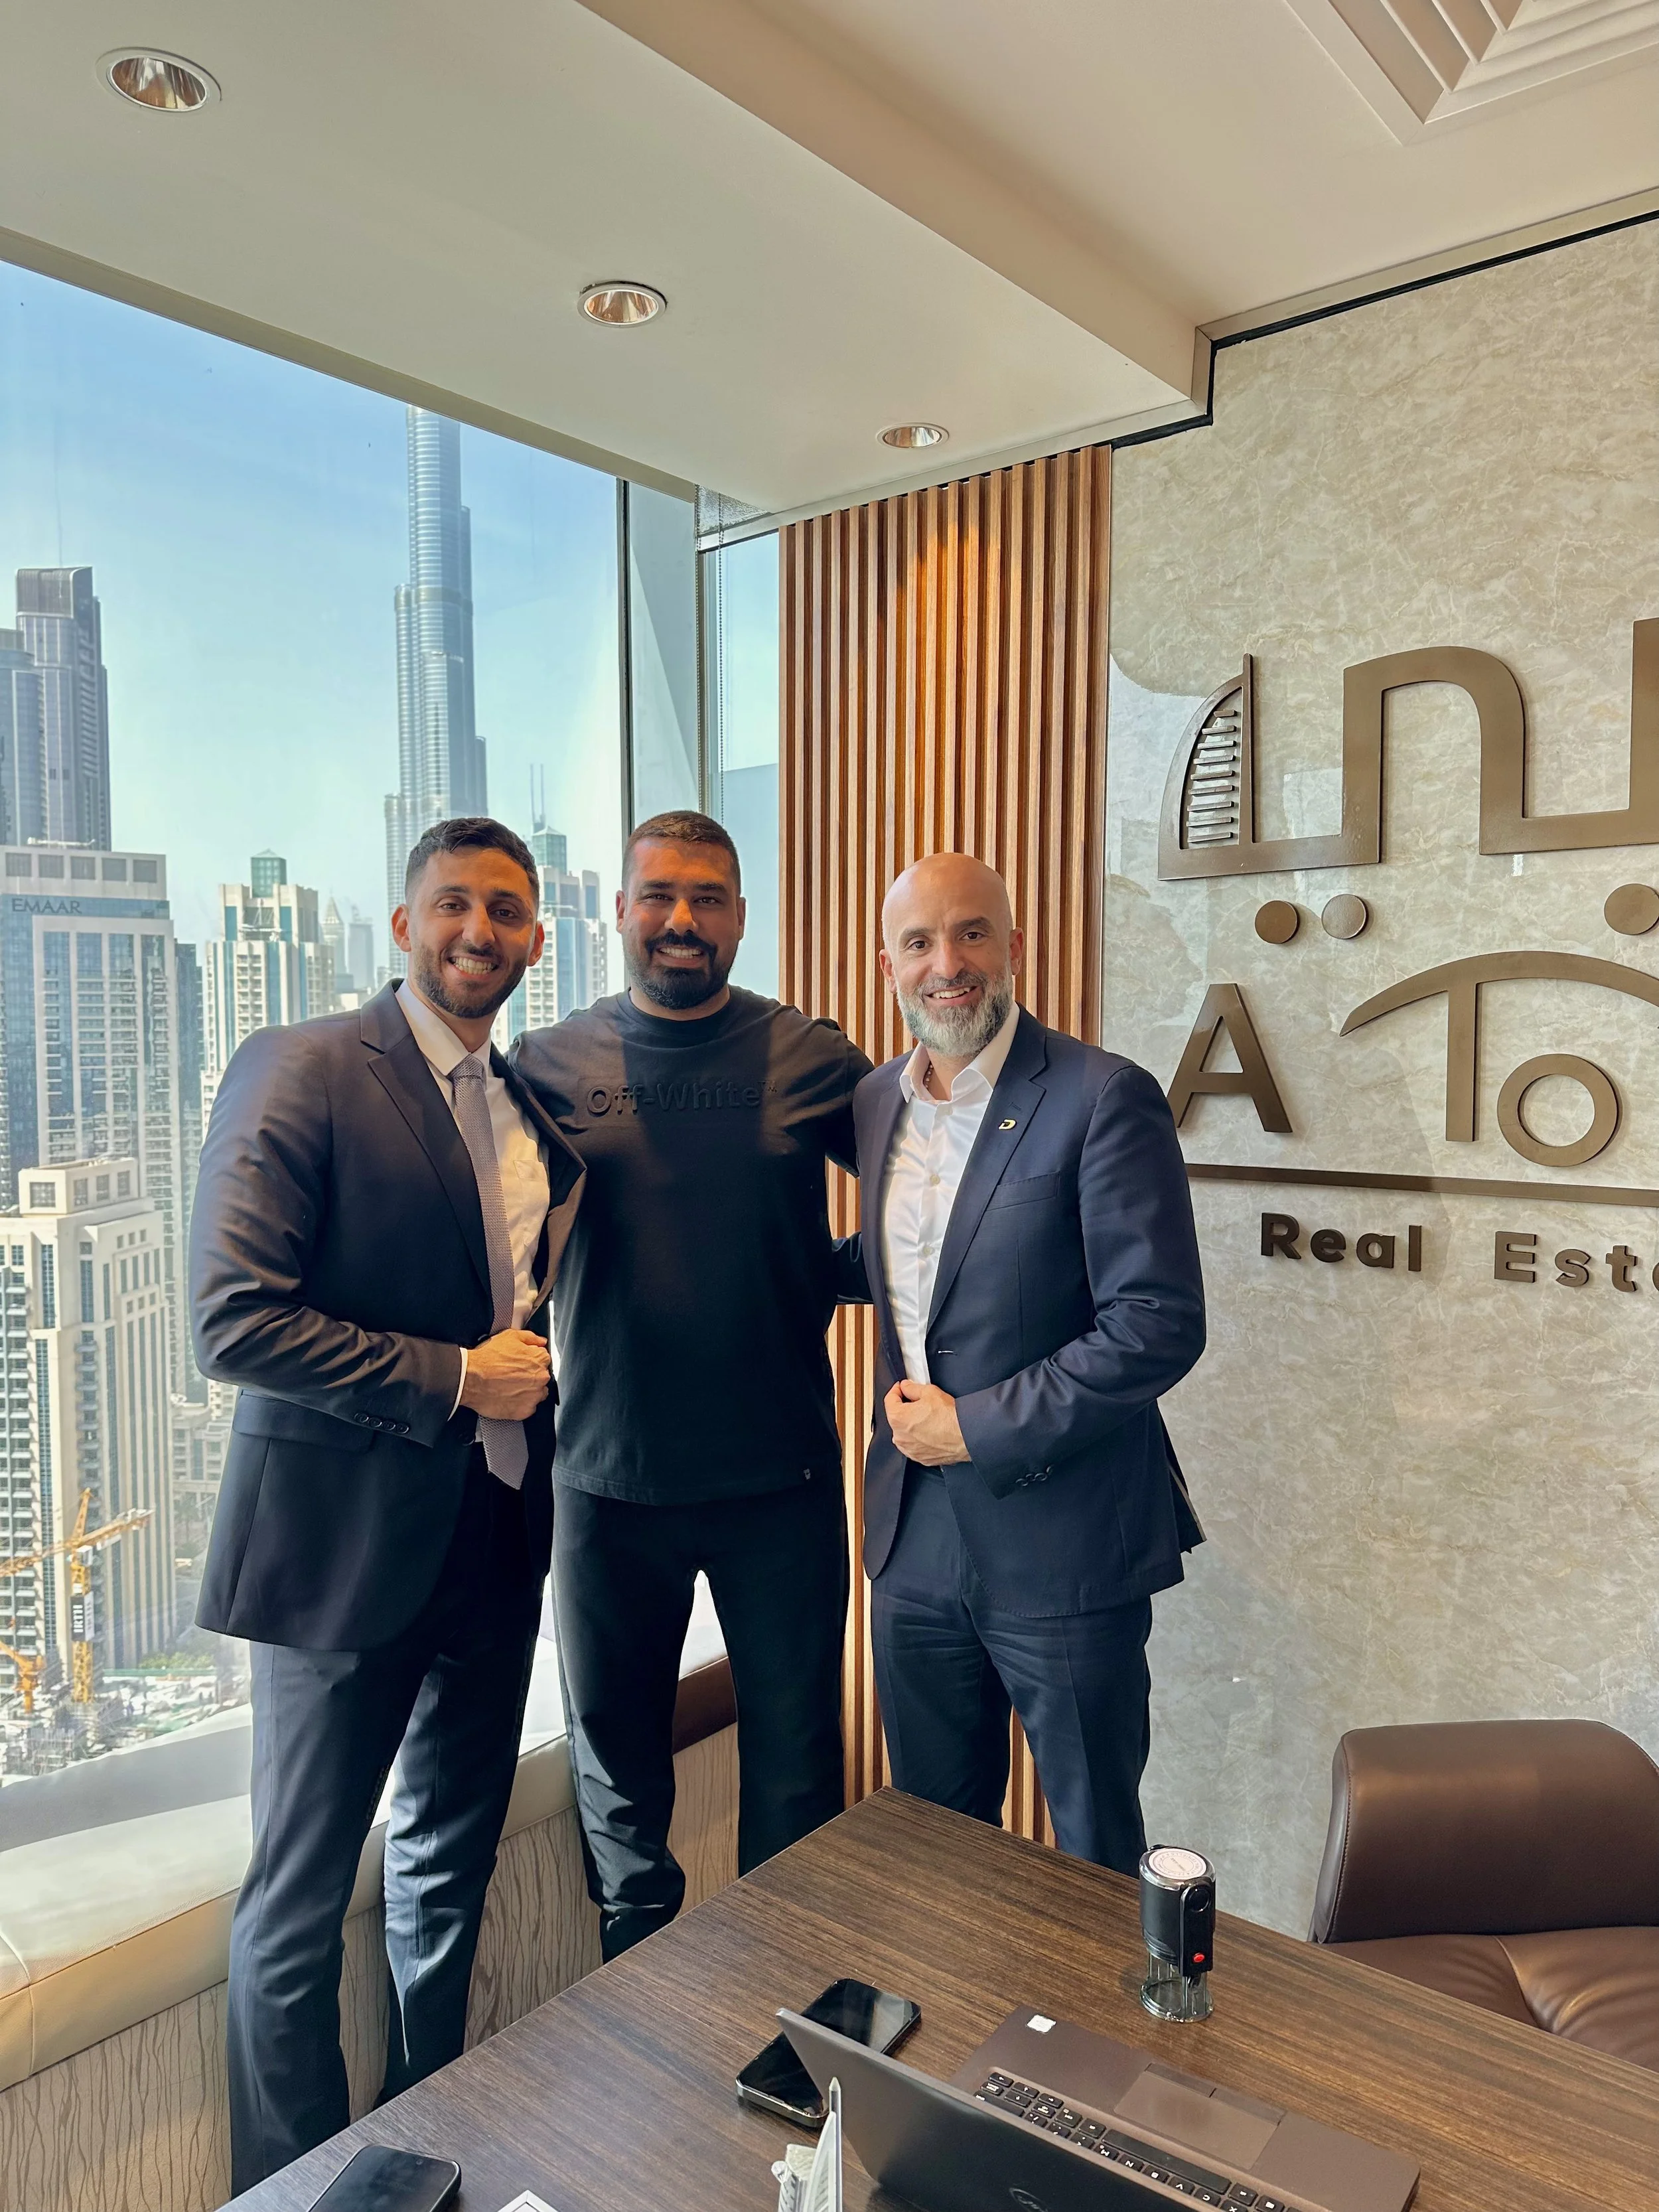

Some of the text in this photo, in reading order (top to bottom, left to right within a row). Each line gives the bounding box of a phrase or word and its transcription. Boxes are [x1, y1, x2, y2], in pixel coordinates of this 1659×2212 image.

[12, 899, 82, 914] EMAAR
[1166, 983, 1293, 1133] A
[1261, 1212, 1659, 1293] Real Est
